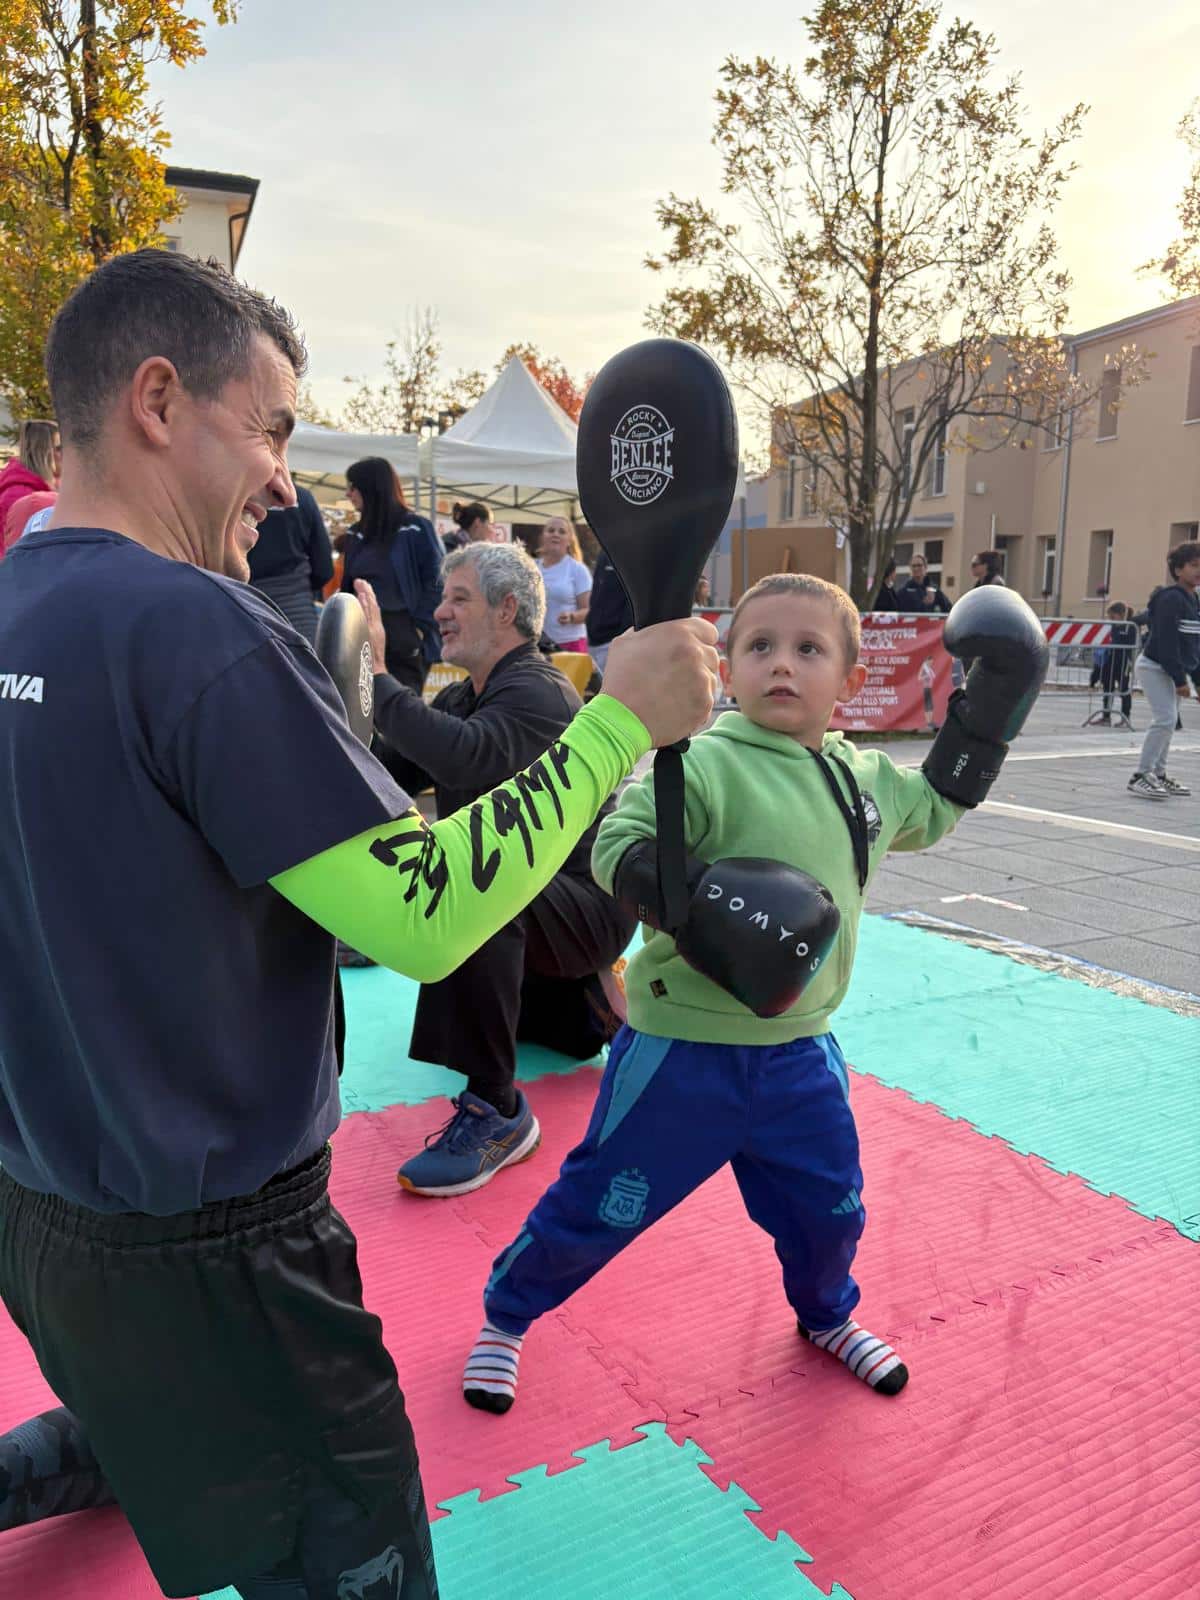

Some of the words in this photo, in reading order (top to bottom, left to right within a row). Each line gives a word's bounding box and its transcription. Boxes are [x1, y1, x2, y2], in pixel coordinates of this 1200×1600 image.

[627, 411, 656, 425] ROCKY
[611, 432, 673, 477] BENLEE
[621, 477, 662, 498] MARCIANO
[952, 753, 969, 777] 12oz
[706, 884, 821, 972] DOMYOS
